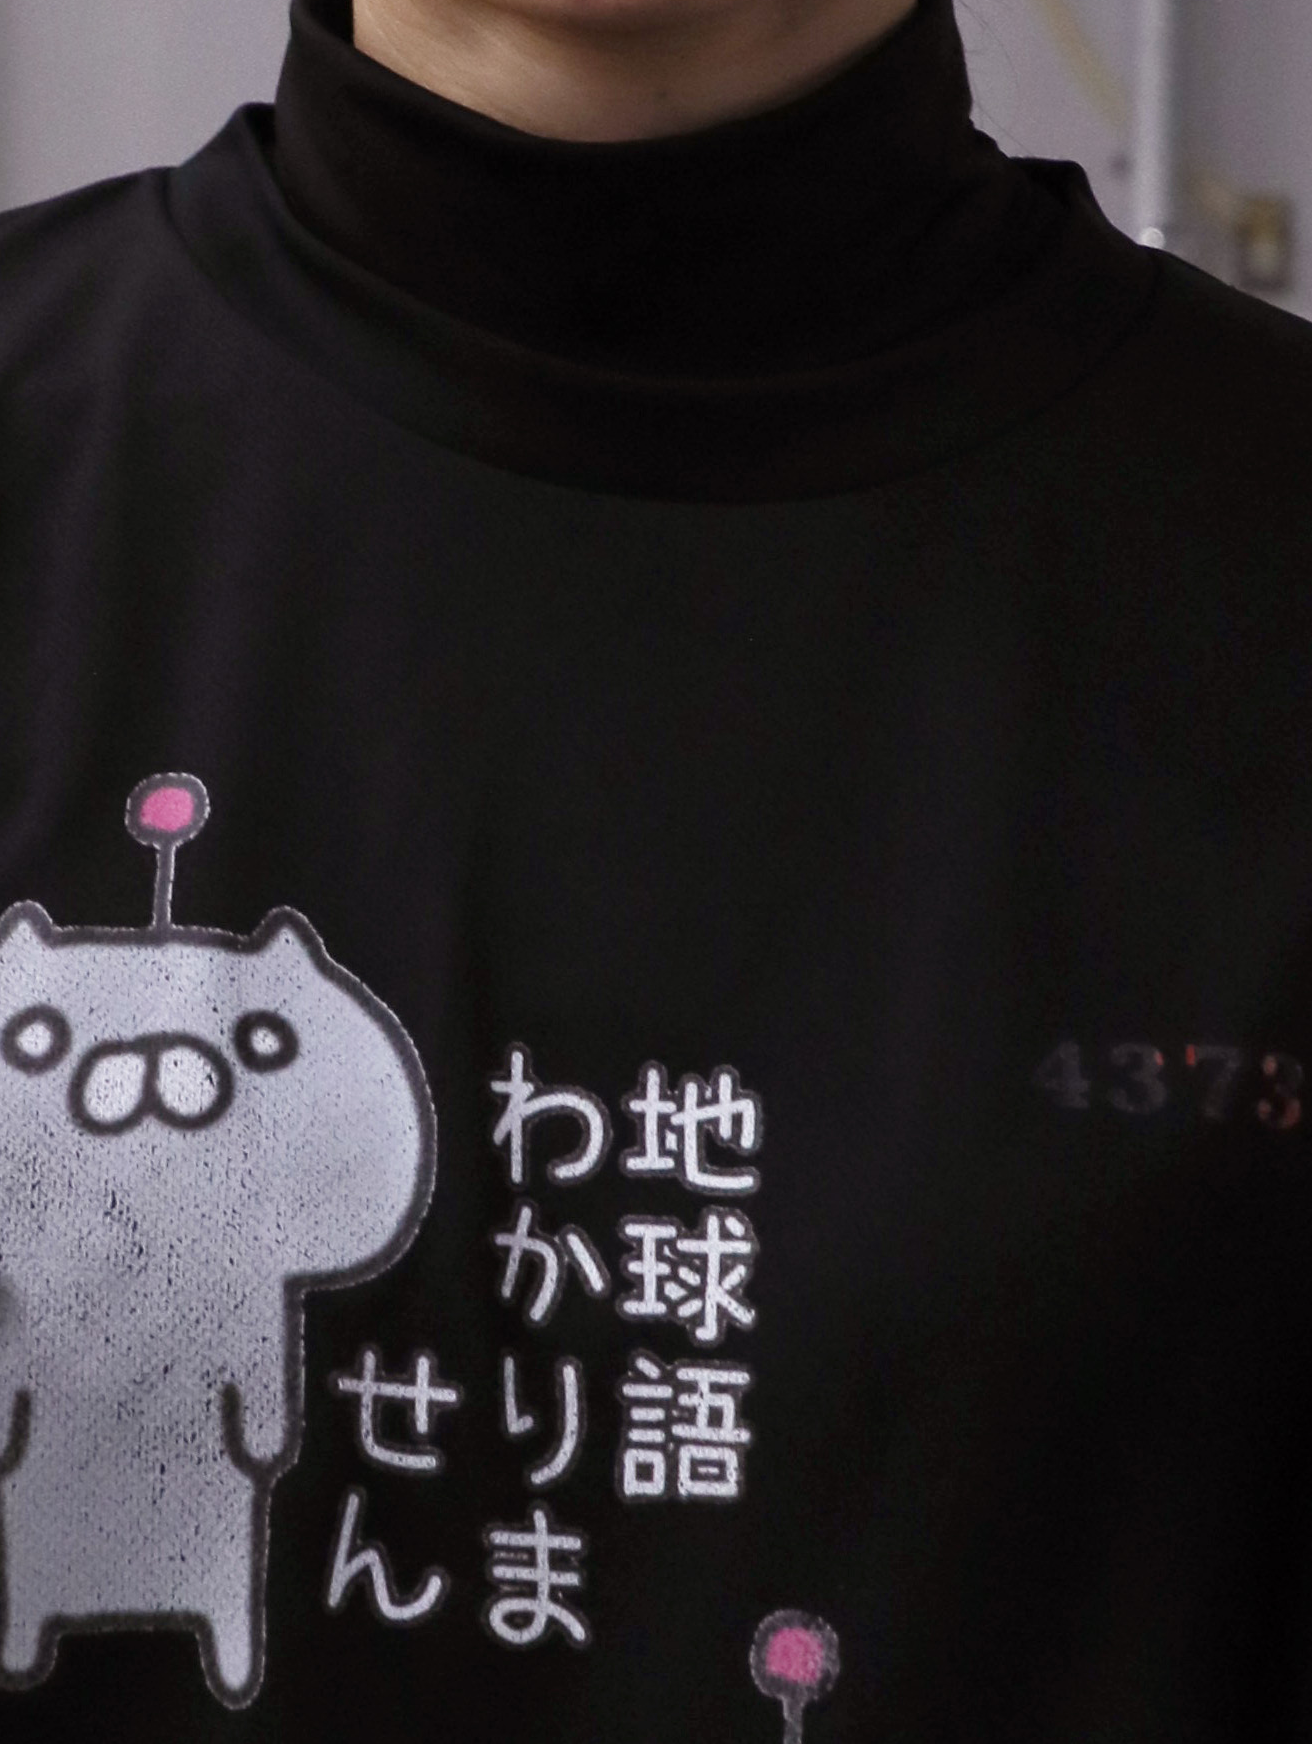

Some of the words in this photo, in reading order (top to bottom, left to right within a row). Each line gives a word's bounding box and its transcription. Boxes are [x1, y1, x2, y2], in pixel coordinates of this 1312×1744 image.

[327, 1351, 461, 1621] せん
[489, 1050, 609, 1646] わかりま
[620, 1067, 758, 1499] 地球語
